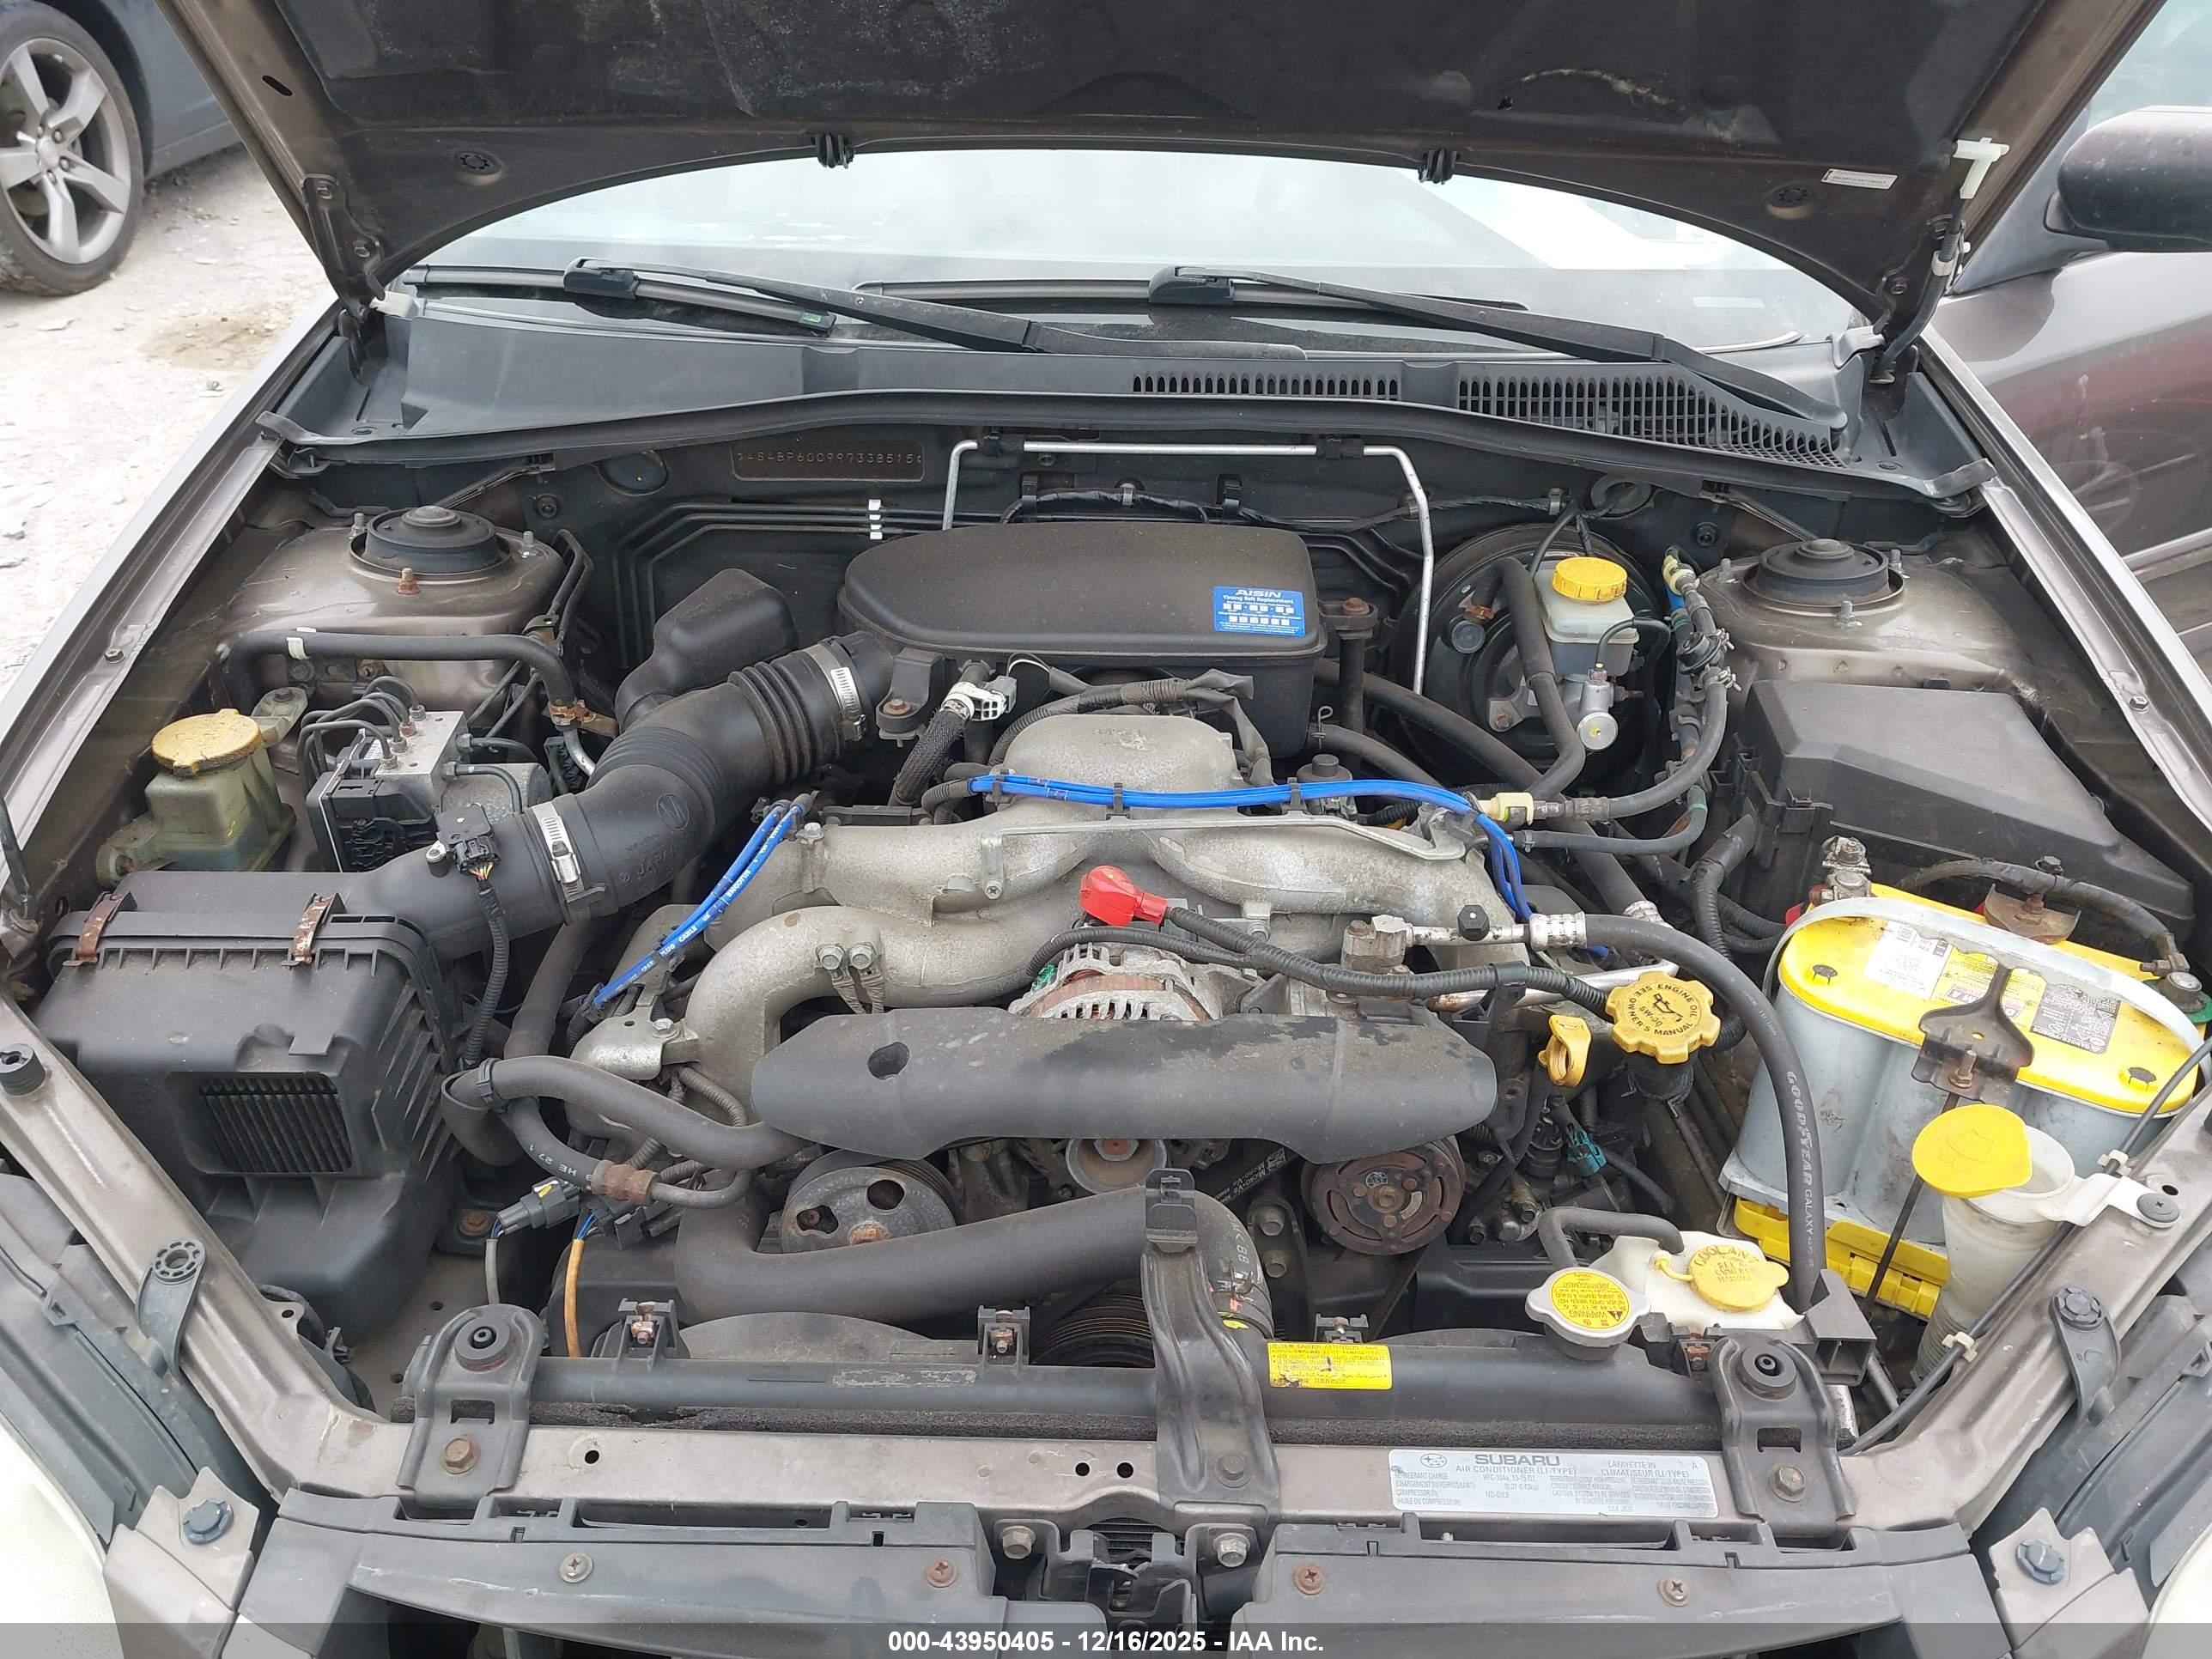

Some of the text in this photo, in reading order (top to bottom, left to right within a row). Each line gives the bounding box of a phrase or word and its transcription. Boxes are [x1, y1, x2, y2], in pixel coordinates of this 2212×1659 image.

[1235, 590, 1281, 599] AISIN
[1657, 983, 1698, 1018] ENGINE OIL
[1634, 985, 1653, 996] SEE
[1654, 1023, 1693, 1036] MANUAL
[1786, 1070, 1813, 1187] GOODYEAR
[1804, 1188, 1814, 1236] GALAXY
[1568, 1310, 1607, 1318] WARNING
[1474, 1454, 1560, 1466] SUBARU
[1474, 1465, 1535, 1474] CONDITIONER
[1537, 1467, 1577, 1475] (LI-TYPE)
[1691, 1462, 1698, 1470] A
[1601, 1468, 1689, 1478] CLIMATISEUR (LI-TYPE)
